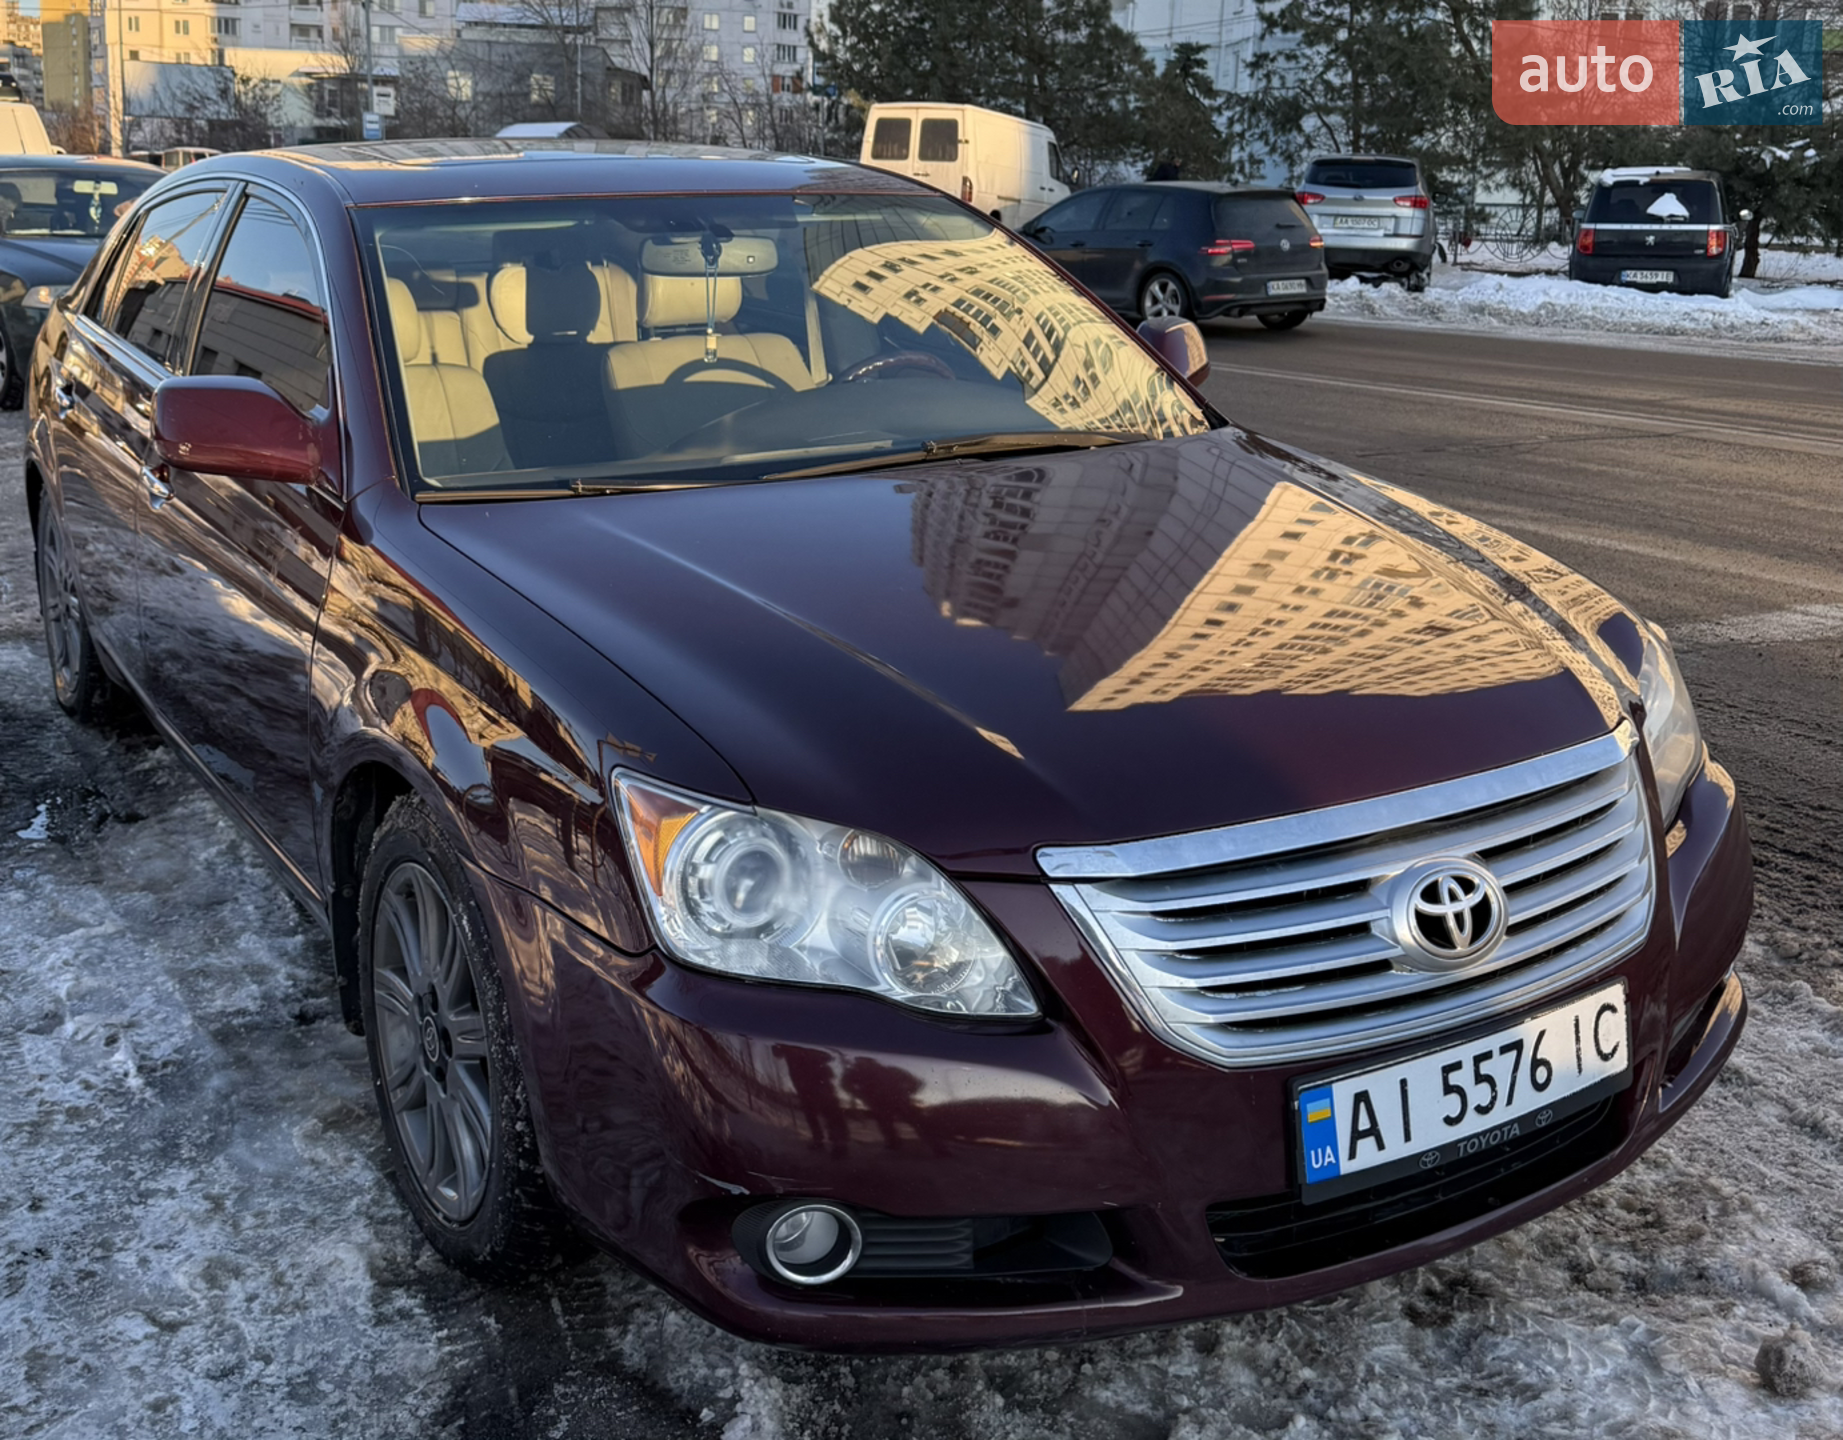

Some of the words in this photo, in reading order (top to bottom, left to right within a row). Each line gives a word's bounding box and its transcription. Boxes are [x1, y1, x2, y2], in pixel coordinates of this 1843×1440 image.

[1347, 1078, 1412, 1161] AI
[1441, 1028, 1553, 1128] 5576
[1573, 1002, 1621, 1077] IC
[1310, 1146, 1336, 1169] UA
[1457, 1122, 1521, 1158] TOYOTA
